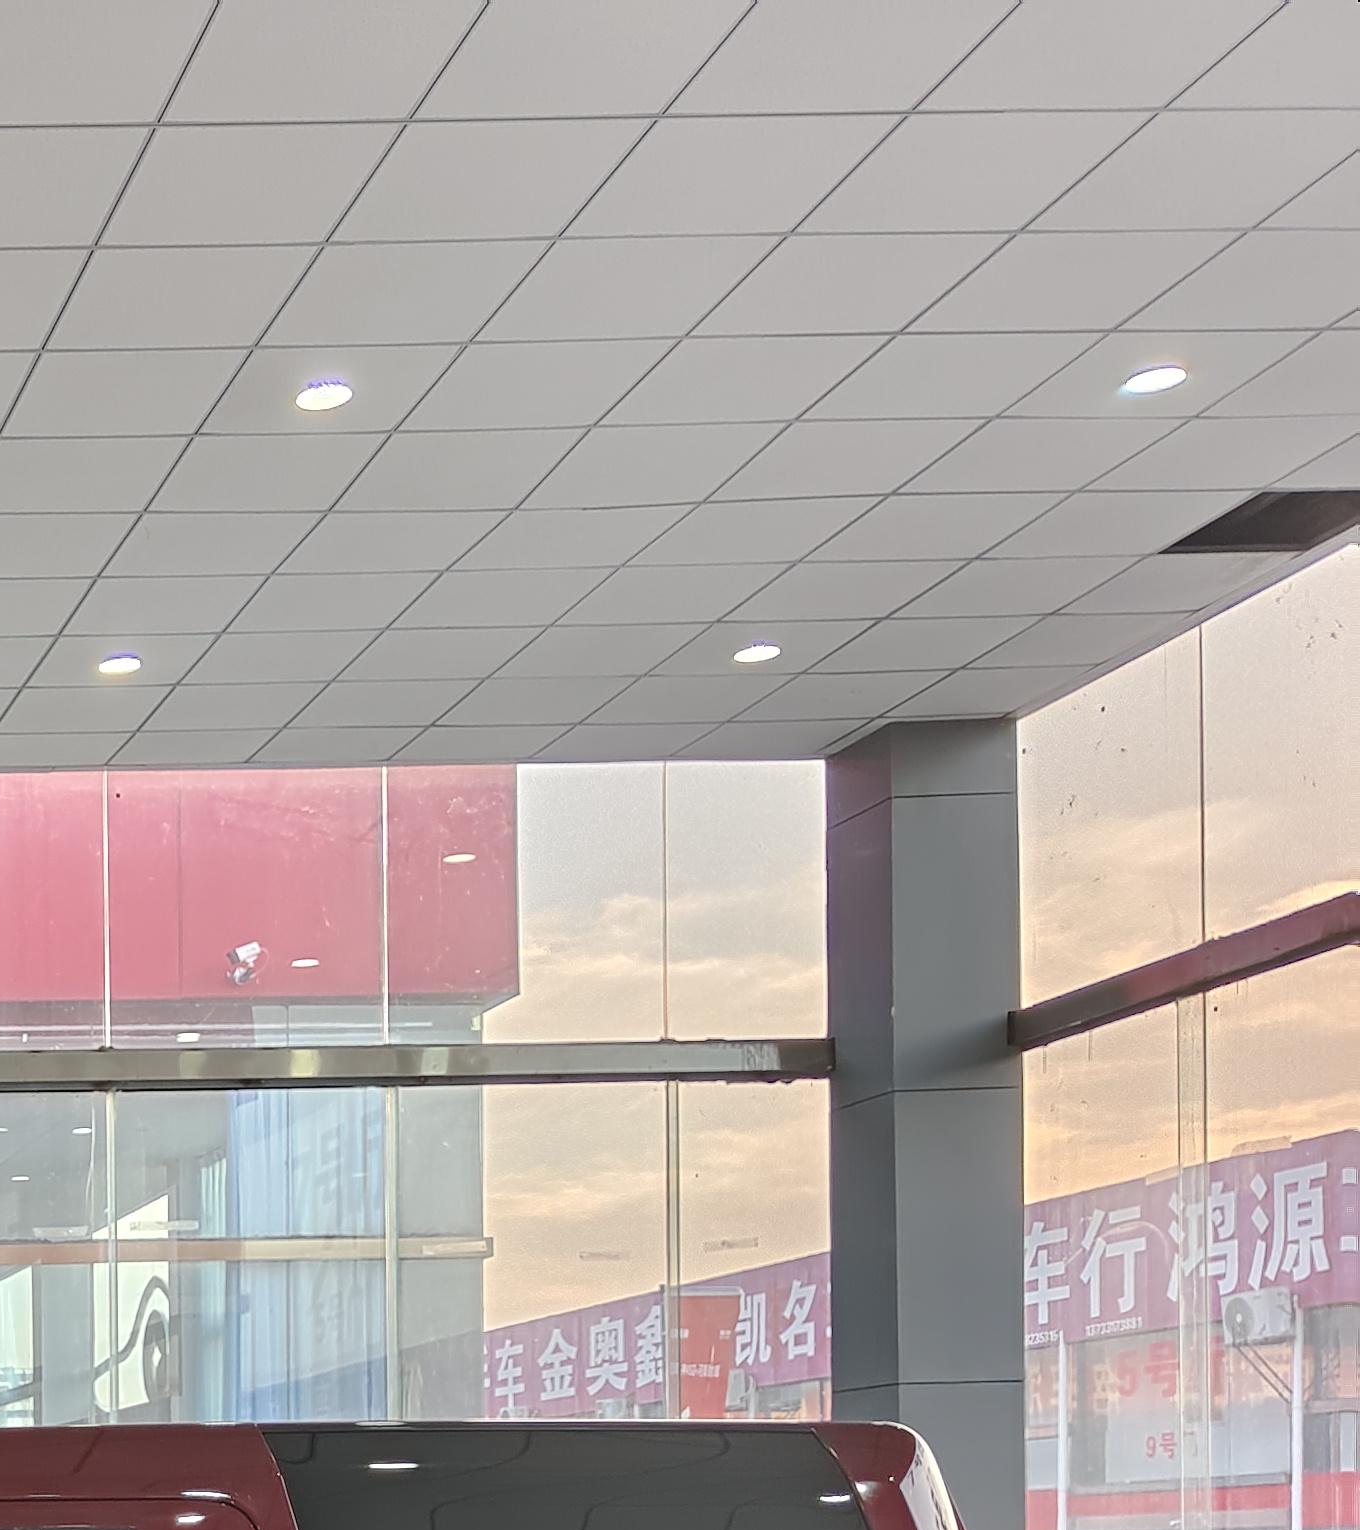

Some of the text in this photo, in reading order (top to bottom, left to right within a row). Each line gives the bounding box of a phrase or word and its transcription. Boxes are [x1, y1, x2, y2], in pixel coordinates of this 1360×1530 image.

[483, 1304, 664, 1411] 车金奥鑫
[734, 1278, 832, 1367] 凯名
